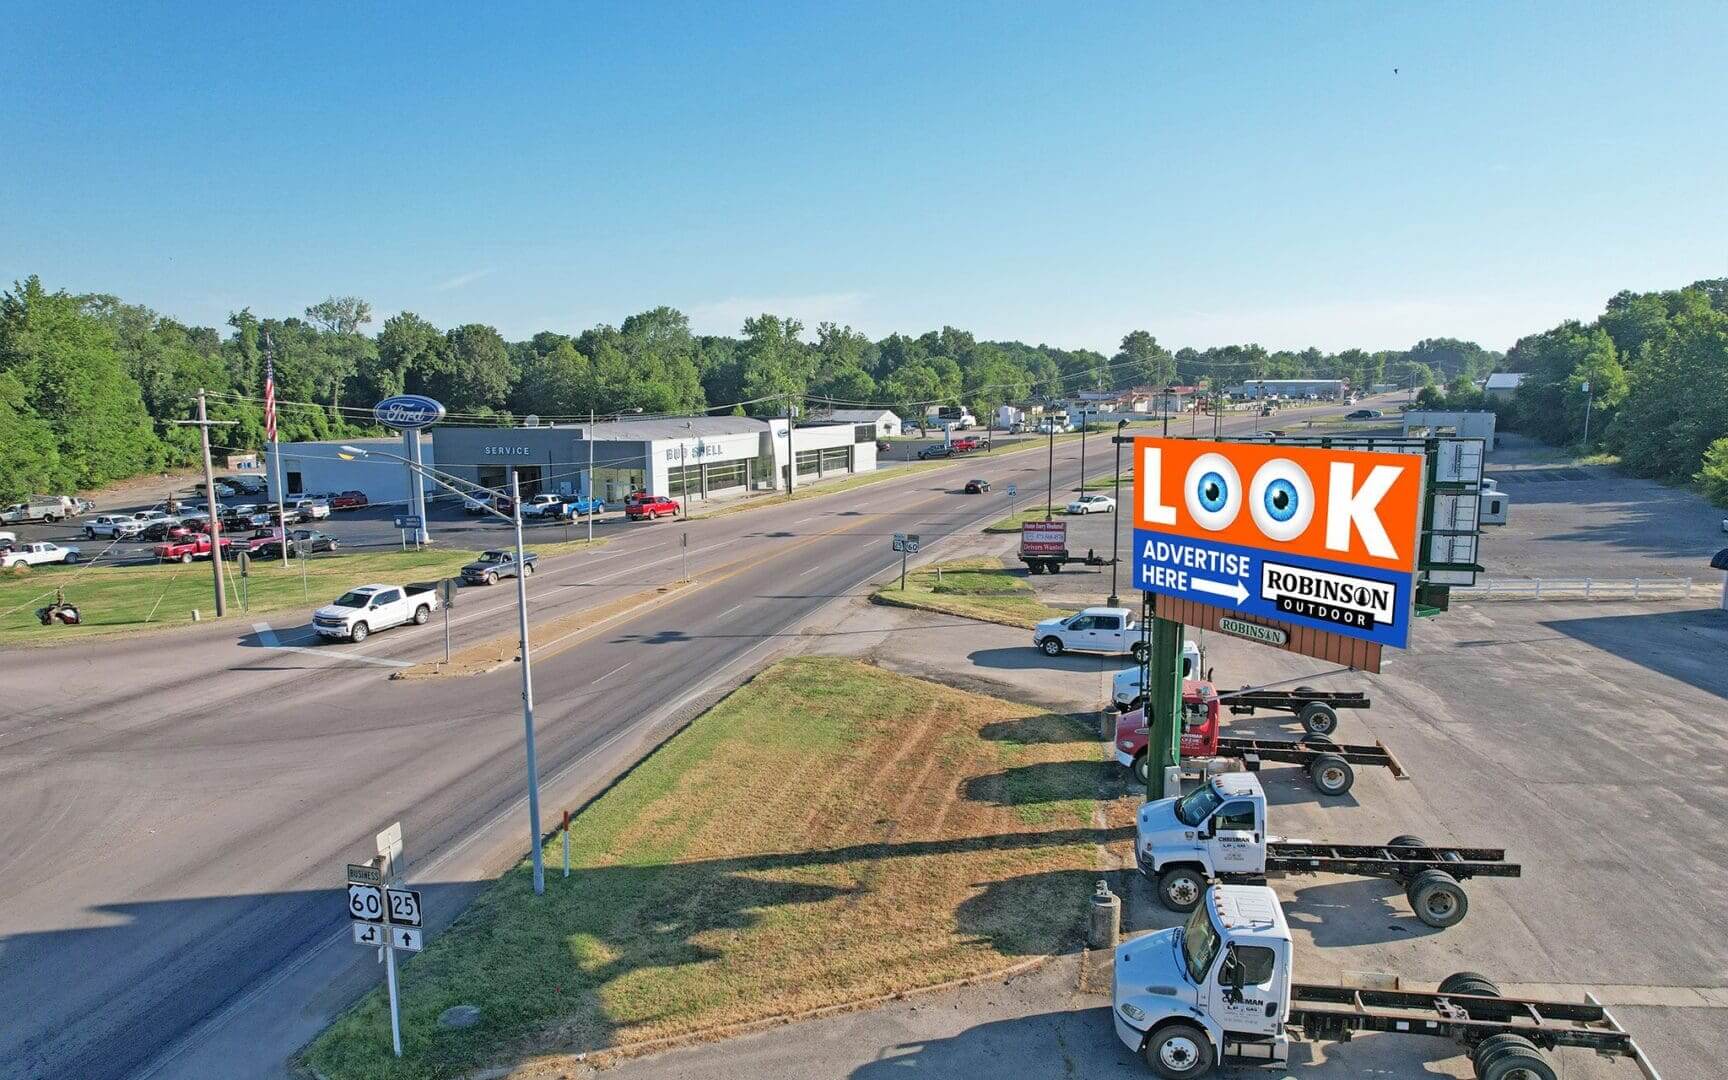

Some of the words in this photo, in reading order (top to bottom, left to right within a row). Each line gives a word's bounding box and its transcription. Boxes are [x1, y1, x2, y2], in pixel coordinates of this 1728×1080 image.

[387, 402, 426, 421] Ford
[485, 446, 530, 455] SERVICE
[1143, 446, 1405, 560] LOOK
[907, 543, 918, 551] 60
[1142, 539, 1250, 578] ADVERTISE
[1142, 563, 1188, 592] HERE
[1267, 569, 1390, 611] ROBINSON
[1283, 598, 1366, 627] OUTDOOR
[350, 868, 379, 881] BUSINESS
[352, 892, 379, 914] 60
[393, 895, 413, 916] 25
